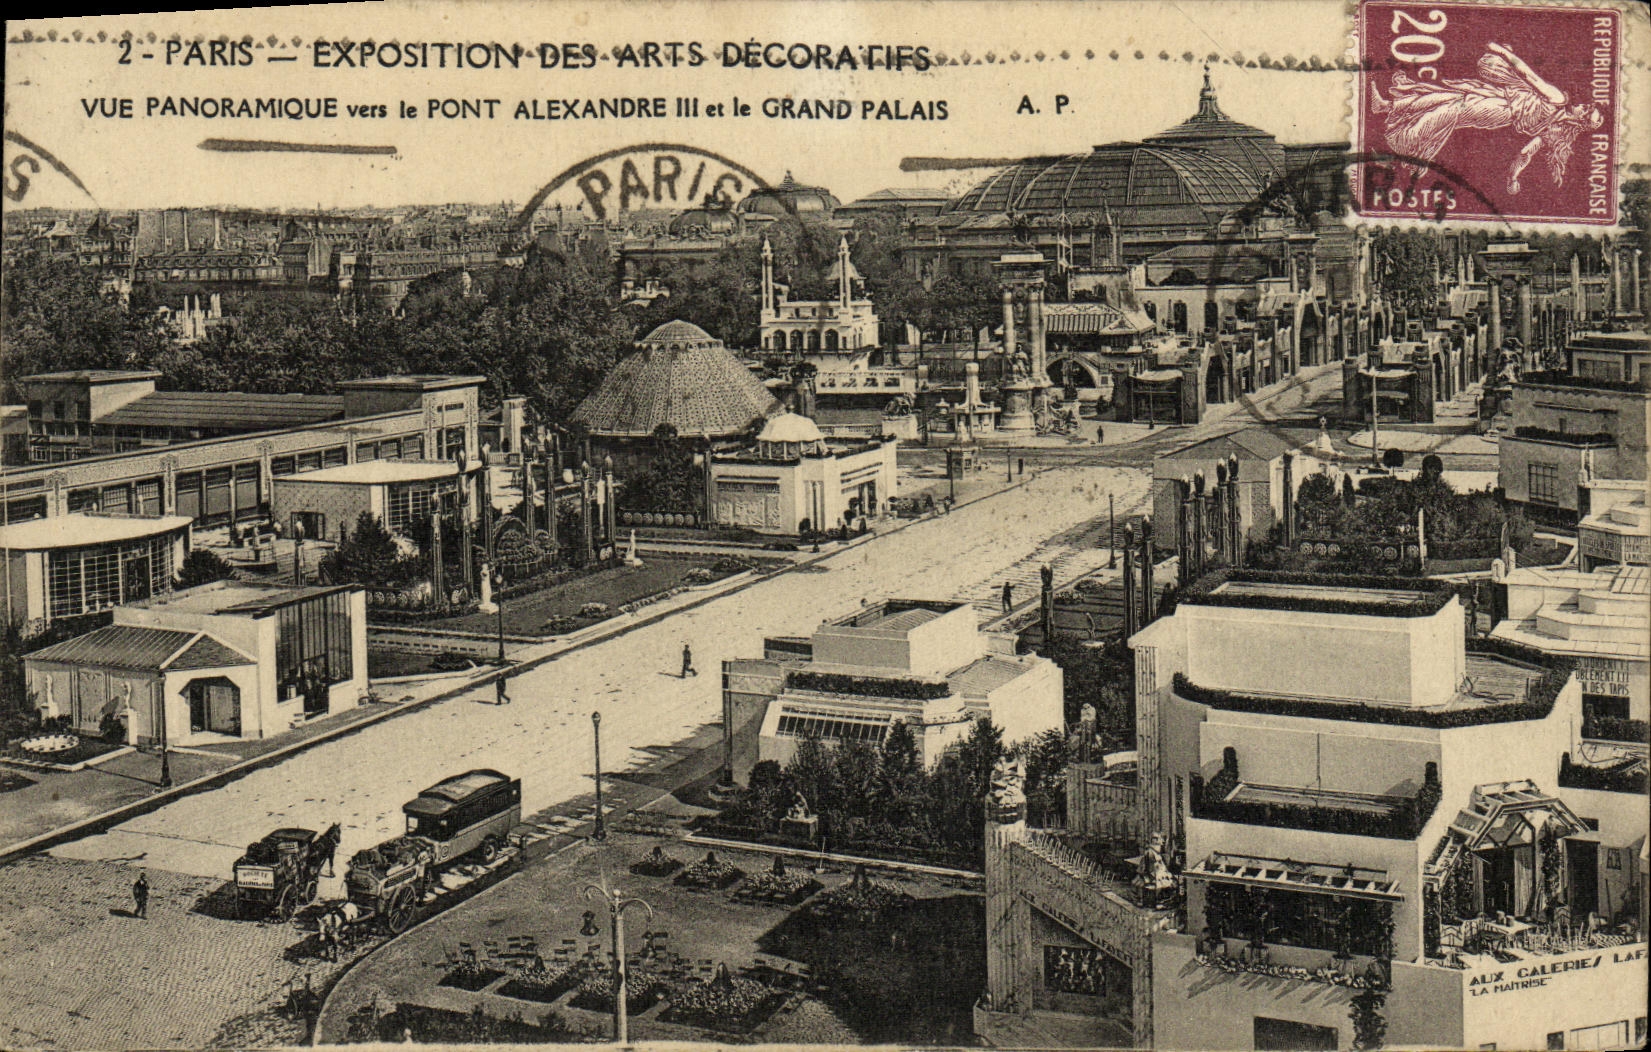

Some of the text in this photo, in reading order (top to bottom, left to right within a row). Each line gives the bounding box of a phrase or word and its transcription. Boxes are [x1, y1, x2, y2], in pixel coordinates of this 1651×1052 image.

[577, 155, 743, 222] PARIS
[1374, 189, 1457, 209] POSTES
[1590, 681, 1606, 695] DES
[1608, 683, 1630, 697] TAPIS
[1469, 971, 1504, 987] AUX
[1517, 955, 1602, 979] GALERIES
